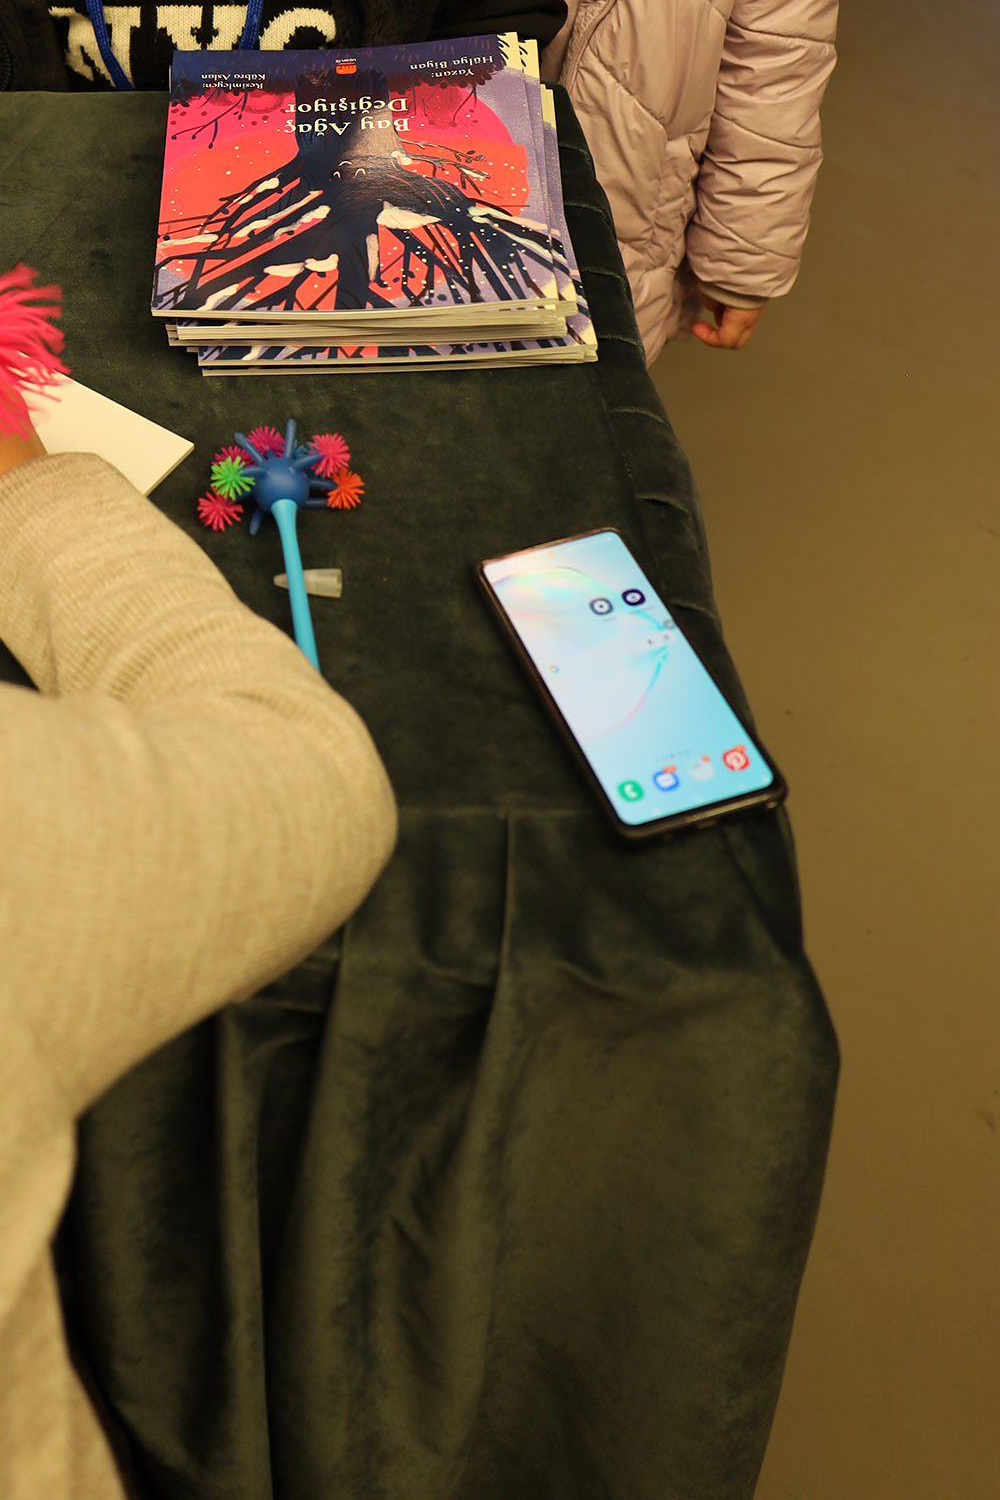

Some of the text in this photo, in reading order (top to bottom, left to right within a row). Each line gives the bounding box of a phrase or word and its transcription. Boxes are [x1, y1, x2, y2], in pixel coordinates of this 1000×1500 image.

[410, 55, 494, 70] Hülya Biyan
[201, 73, 266, 81] Kübra Aslan
[431, 68, 474, 78] Yazan:
[202, 81, 264, 90] Resimleyen:
[285, 96, 409, 116] Değişiyor
[284, 116, 411, 137] Bay Ağaç
